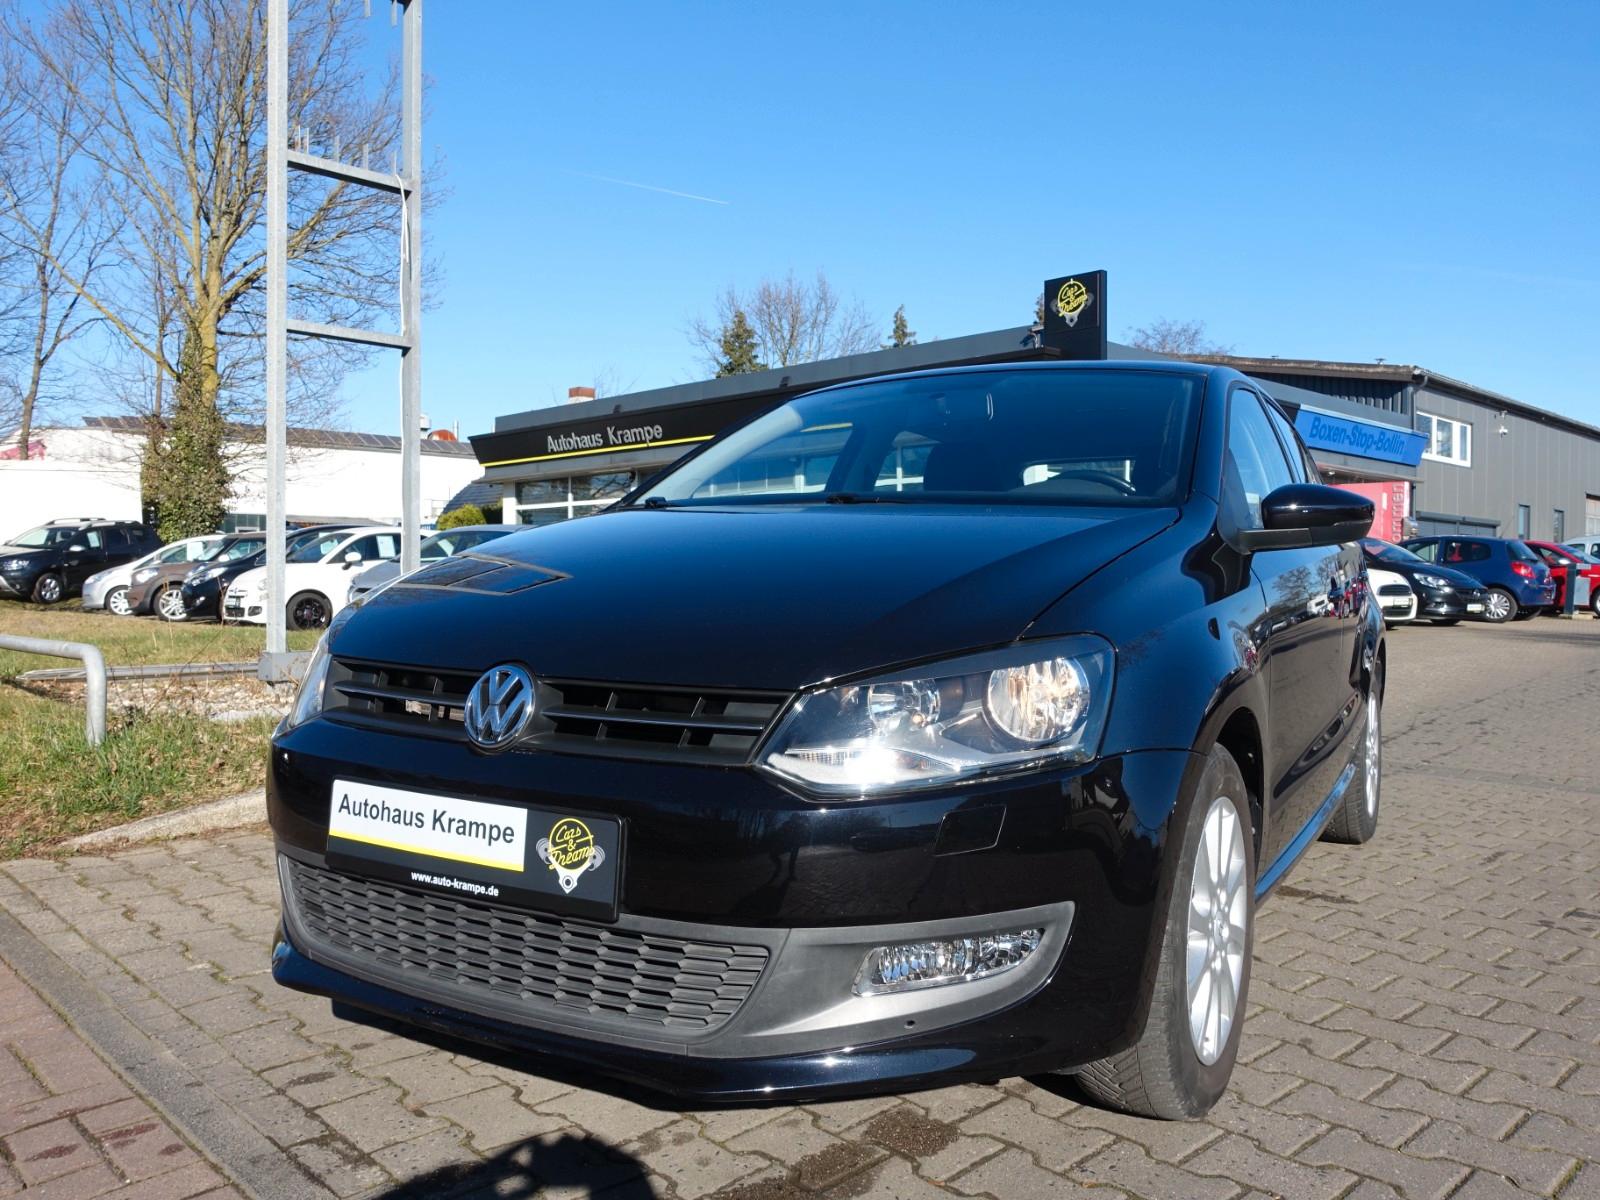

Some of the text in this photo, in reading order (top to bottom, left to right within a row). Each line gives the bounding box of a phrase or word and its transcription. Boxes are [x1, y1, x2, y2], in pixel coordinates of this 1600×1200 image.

[547, 424, 663, 453] Autohaus Krampe
[1309, 417, 1405, 455] Boxen-Stop-Bollin
[1392, 483, 1404, 543] ommen
[338, 793, 515, 847] Autohaus Krampe
[556, 825, 581, 842] Cars
[549, 846, 595, 870] Dreams
[567, 838, 577, 851] &
[410, 871, 499, 897] www.auto-krampe.de
